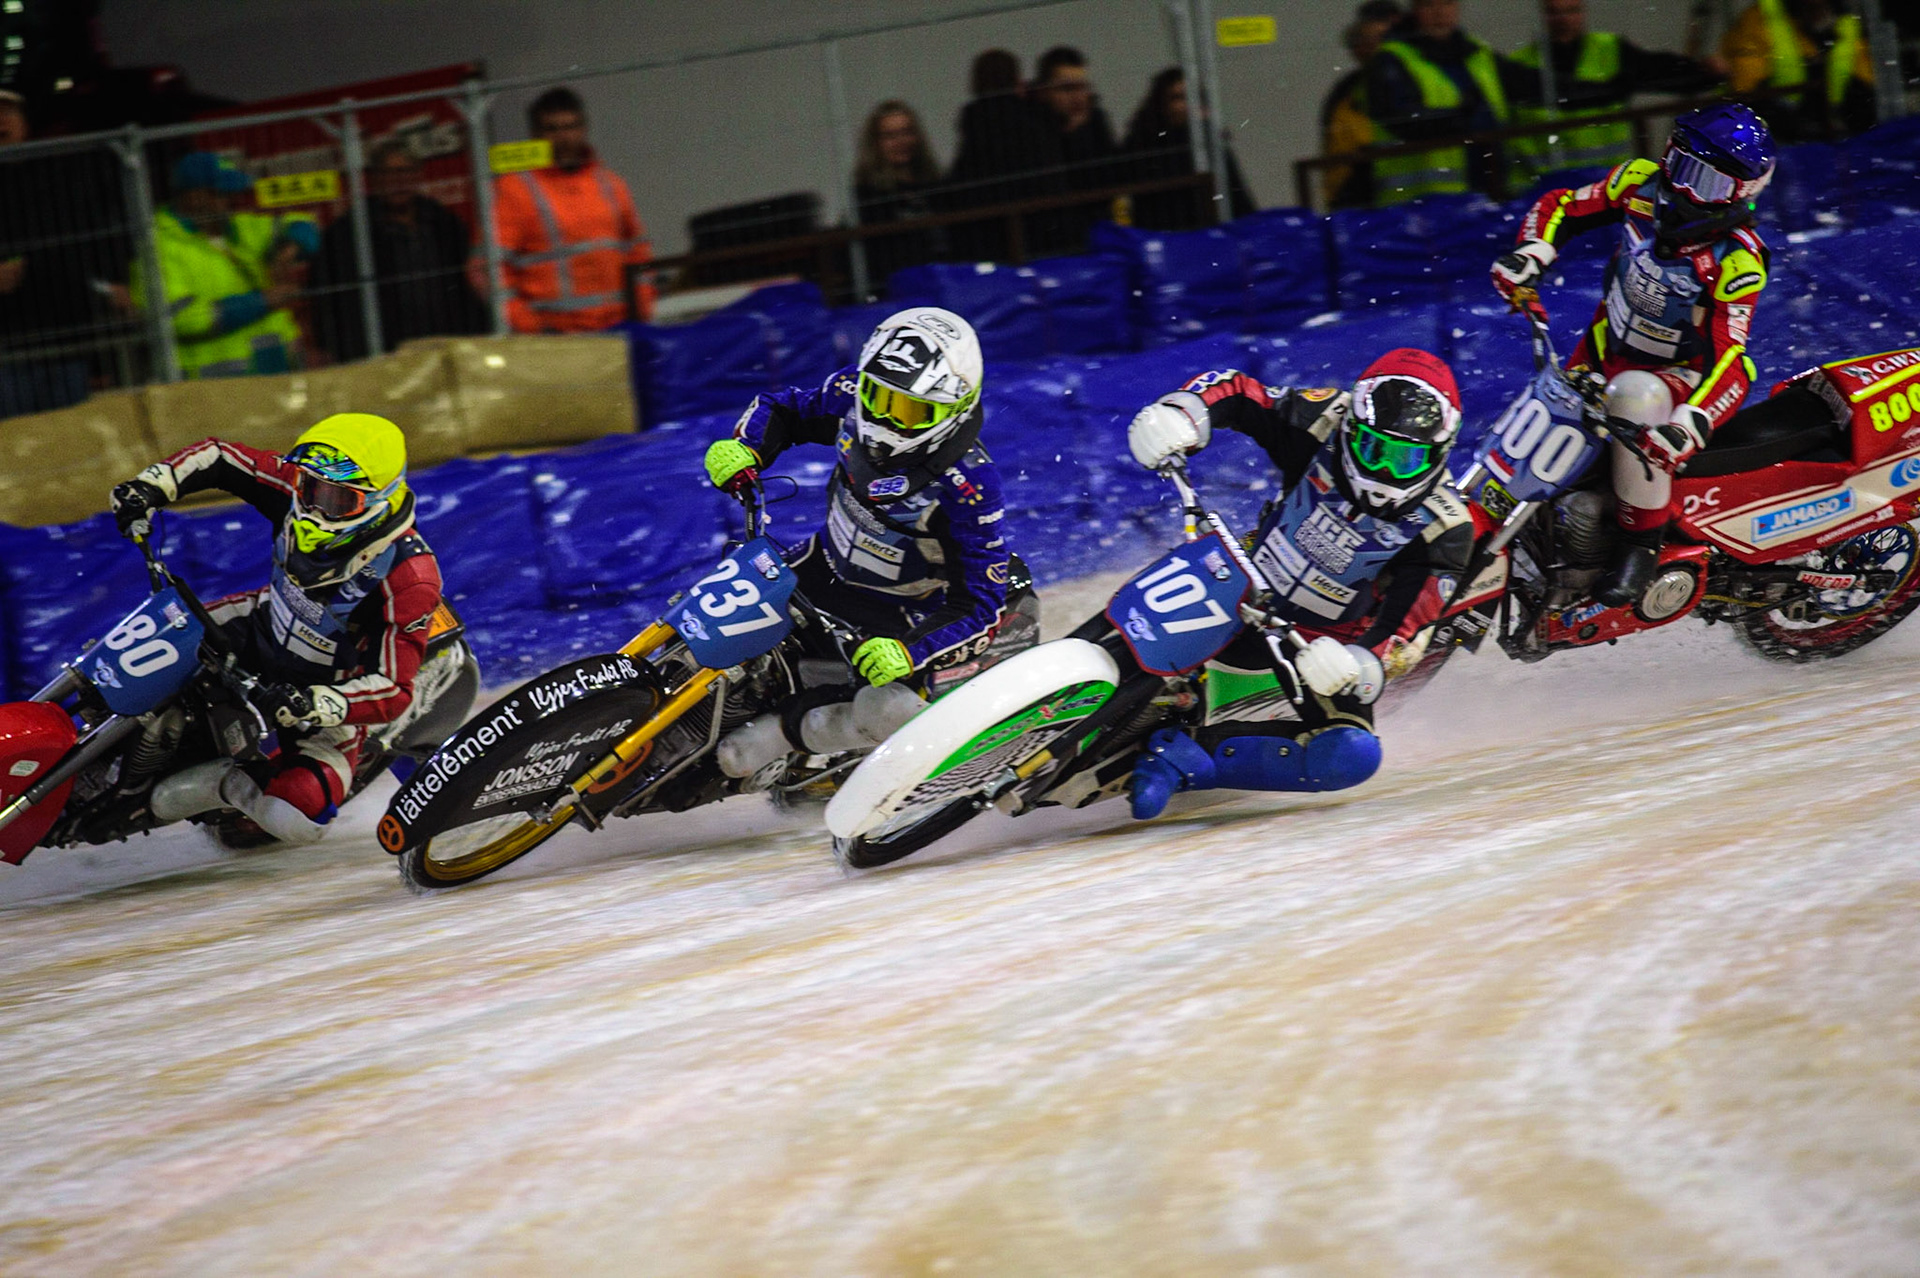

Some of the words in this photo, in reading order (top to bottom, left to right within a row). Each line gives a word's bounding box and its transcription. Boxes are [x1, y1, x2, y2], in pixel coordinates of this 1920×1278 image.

[1638, 320, 1676, 338] Hertz
[1308, 503, 1366, 557] ICE
[1771, 498, 1841, 530] JAMARO
[862, 534, 899, 558] Hertz
[690, 558, 783, 637] 237
[1135, 556, 1232, 634] 107
[1311, 575, 1350, 598] Hertz
[105, 614, 180, 678] 80
[299, 626, 332, 649] Hertz
[617, 658, 640, 679] AB
[484, 751, 581, 792] JONSSON
